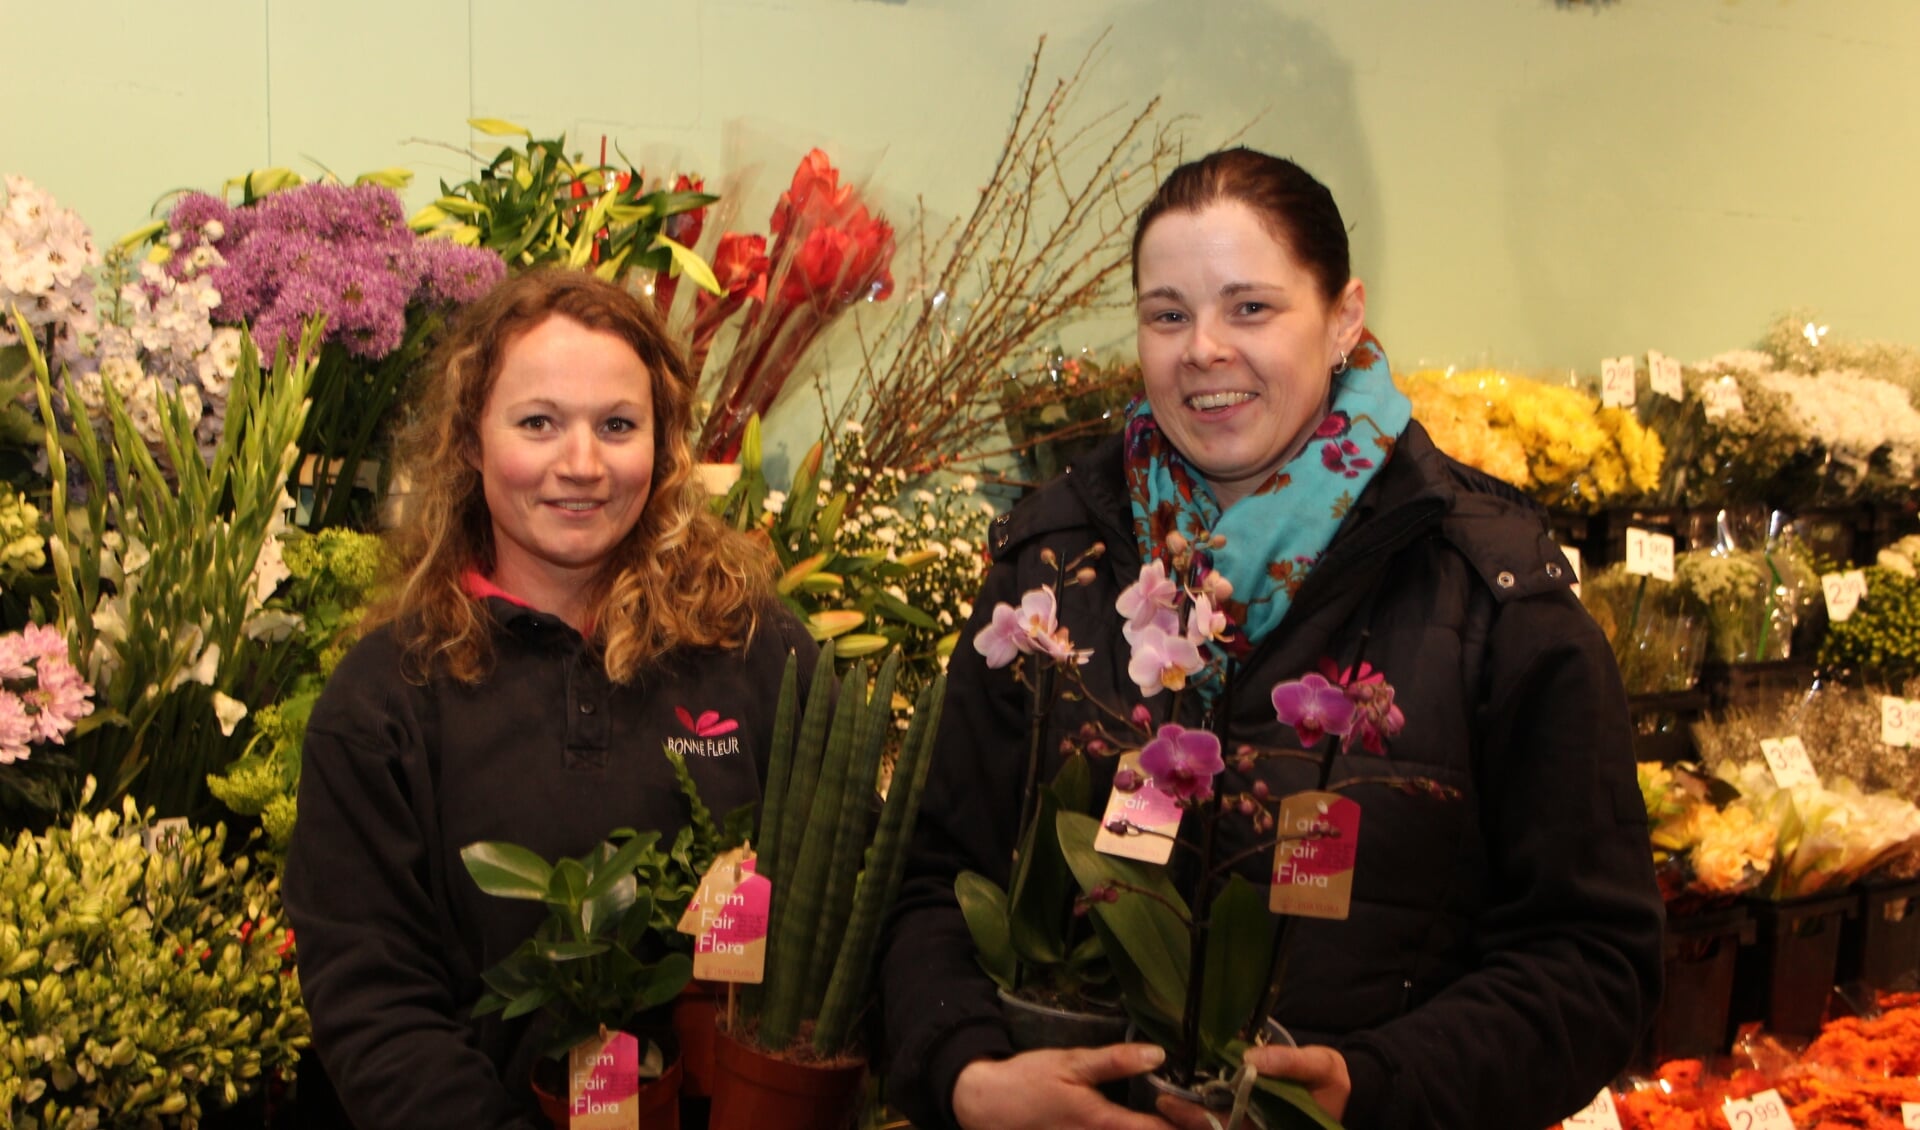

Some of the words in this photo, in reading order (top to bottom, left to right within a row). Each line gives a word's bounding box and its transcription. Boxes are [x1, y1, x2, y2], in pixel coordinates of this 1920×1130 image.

[667, 736, 706, 757] BONNE
[707, 736, 740, 757] FLEUR
[1284, 808, 1290, 831] I
[1277, 862, 1329, 888] Flora
[704, 884, 710, 904] I
[714, 892, 745, 907] am
[701, 908, 736, 930] Fair
[699, 932, 745, 956] Flora
[585, 1053, 615, 1067] am
[574, 1072, 608, 1091] Fair
[574, 1094, 620, 1115] Flora
